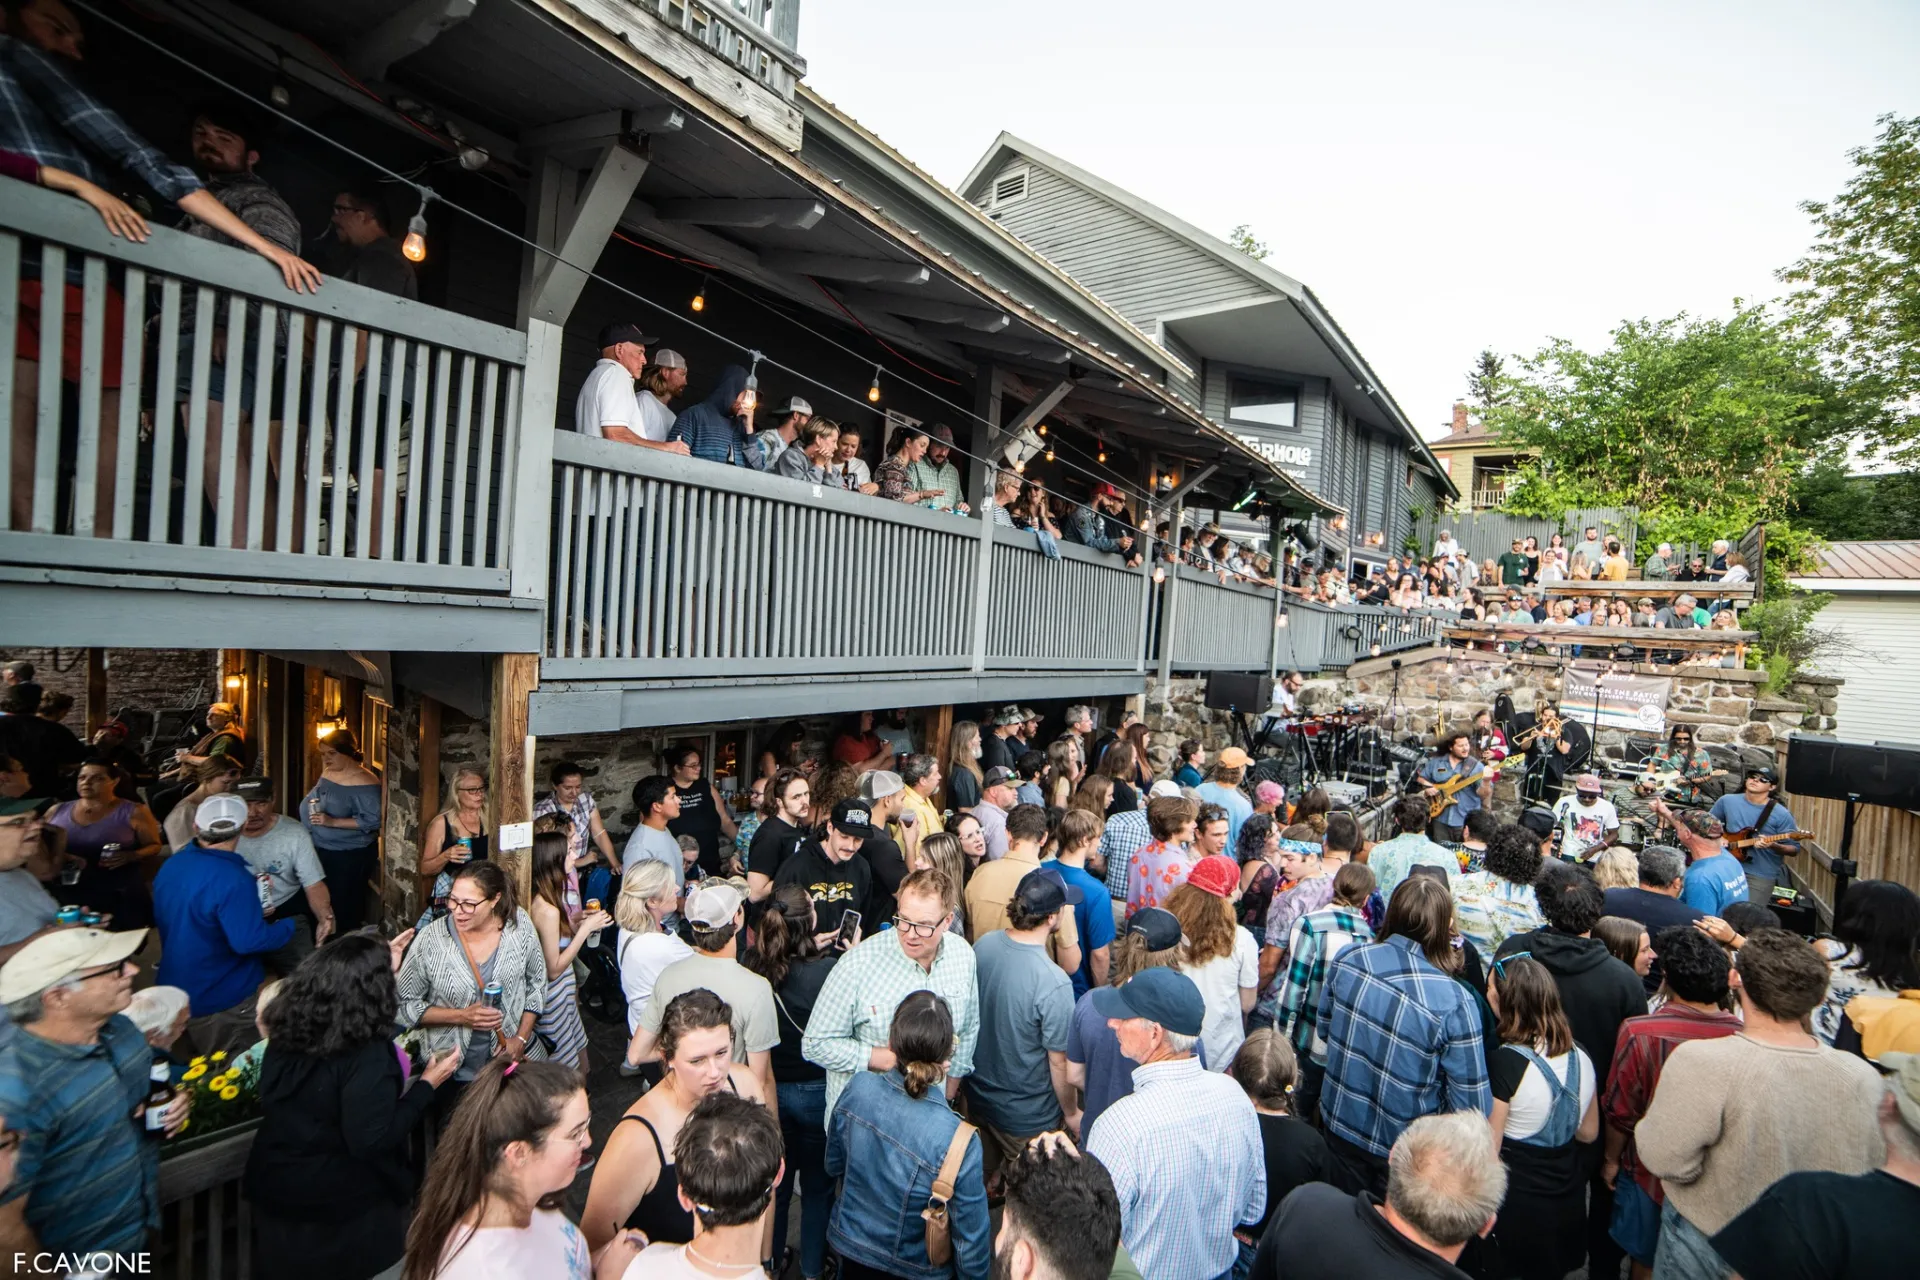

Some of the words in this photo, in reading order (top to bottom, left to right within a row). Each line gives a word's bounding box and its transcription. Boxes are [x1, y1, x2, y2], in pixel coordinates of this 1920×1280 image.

[1569, 684, 1596, 693] PARTY
[1633, 690, 1660, 699] PATIO
[1625, 696, 1659, 704] THURSDAY
